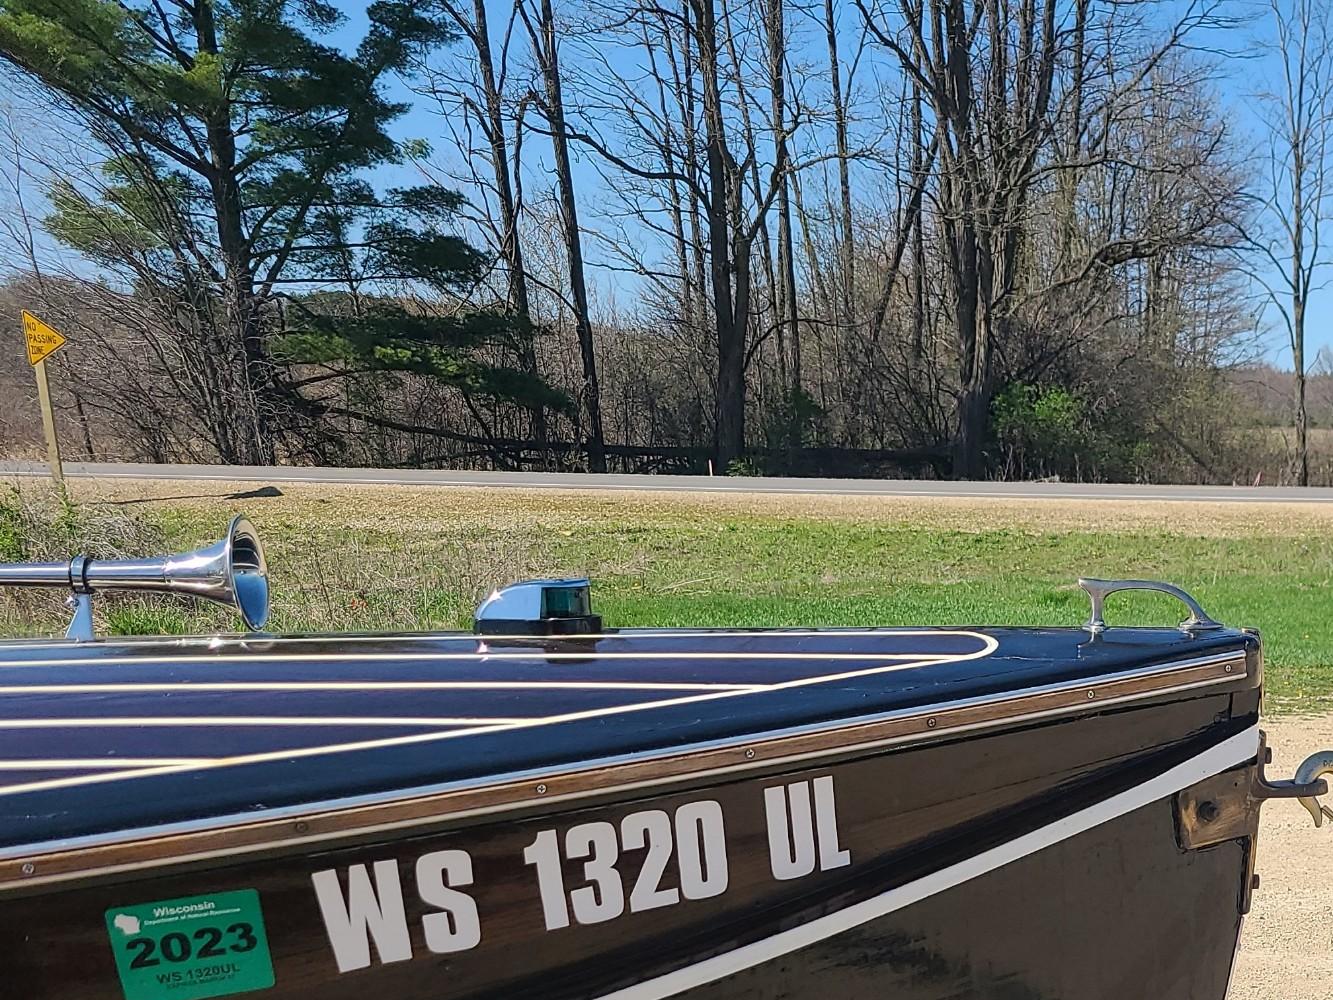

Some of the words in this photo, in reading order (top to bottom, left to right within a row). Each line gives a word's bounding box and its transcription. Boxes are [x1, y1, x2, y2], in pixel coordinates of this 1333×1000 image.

[27, 322, 36, 331] NO
[28, 334, 57, 344] PASSING
[312, 849, 481, 973] WS
[524, 800, 729, 931] 1320
[763, 775, 852, 881] UL
[153, 901, 215, 917] Wisconsin
[126, 922, 258, 969] 2023
[156, 971, 182, 984] WS
[186, 963, 240, 979] 1320UL
